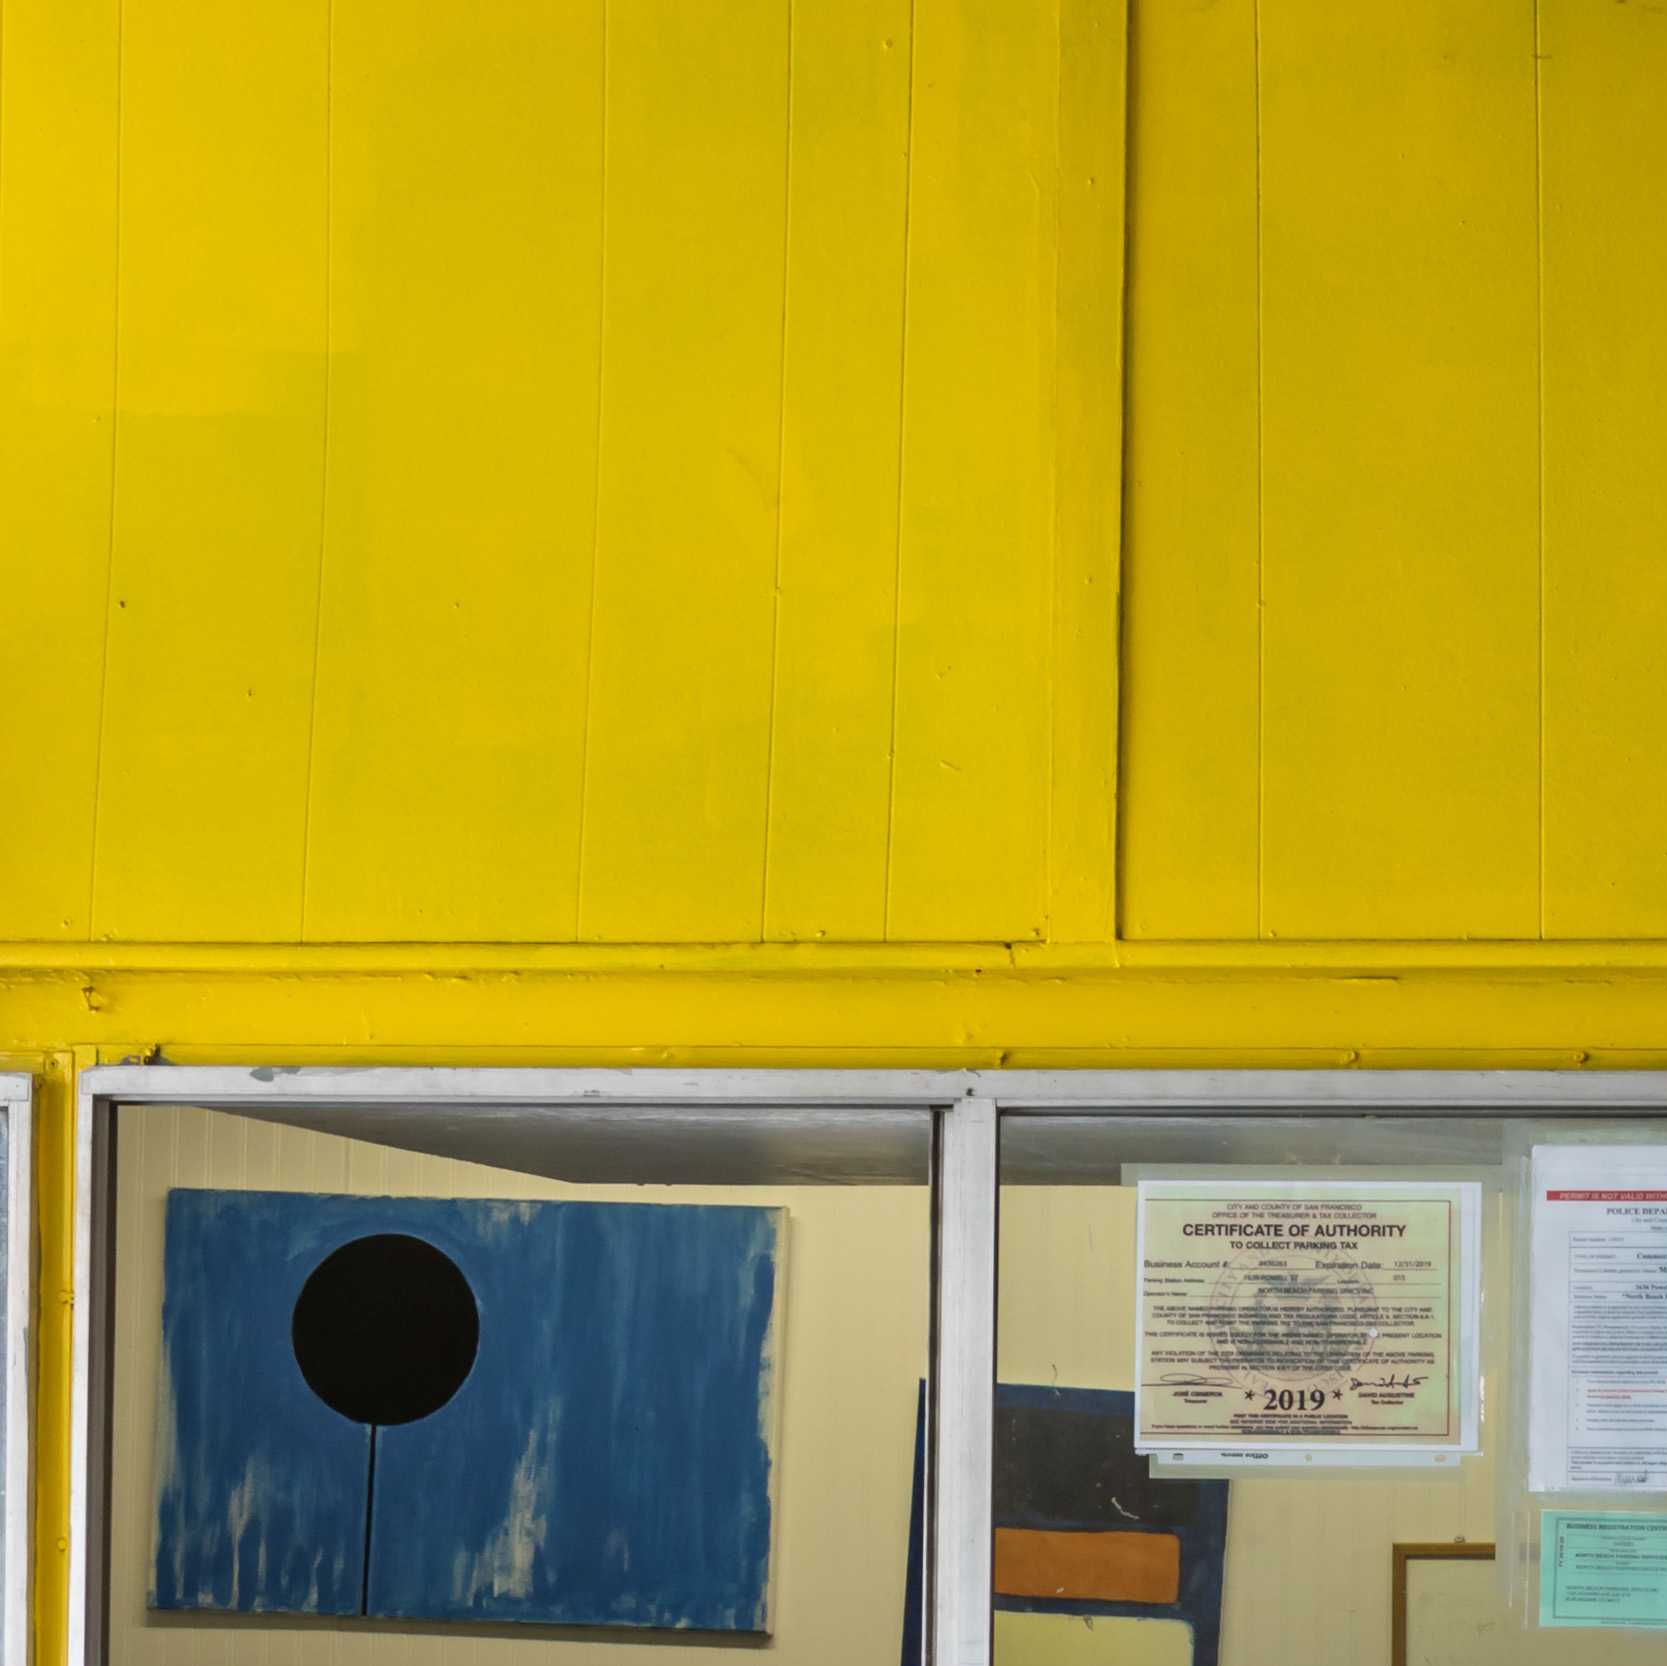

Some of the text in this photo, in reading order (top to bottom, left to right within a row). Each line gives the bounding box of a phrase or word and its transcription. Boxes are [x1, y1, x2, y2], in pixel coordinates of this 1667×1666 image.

[1606, 1207, 1641, 1216] POLICE
[1183, 1224, 1406, 1237] CERTIFICATE OF AUTHORITY
[1230, 1241, 1358, 1250] TO COLLECT PARKING TAX
[1264, 1389, 1325, 1410] 2019
